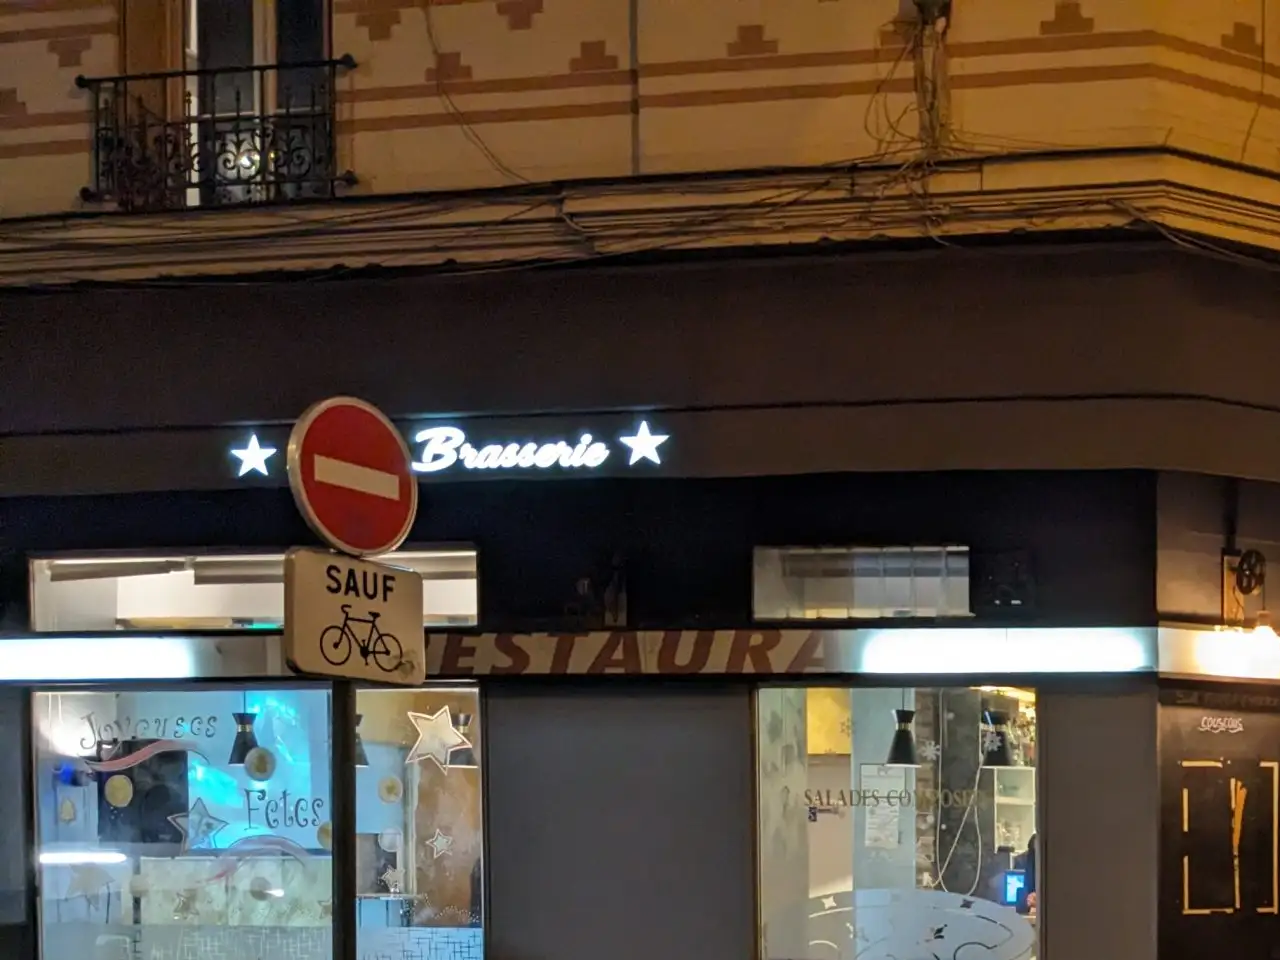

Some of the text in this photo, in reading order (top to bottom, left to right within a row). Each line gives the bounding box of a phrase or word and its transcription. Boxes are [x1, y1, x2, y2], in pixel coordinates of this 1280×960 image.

[411, 426, 609, 472] Brasserie
[326, 564, 396, 602] SAUF
[426, 629, 828, 674] ESTAURA
[804, 789, 882, 807] SALADES
